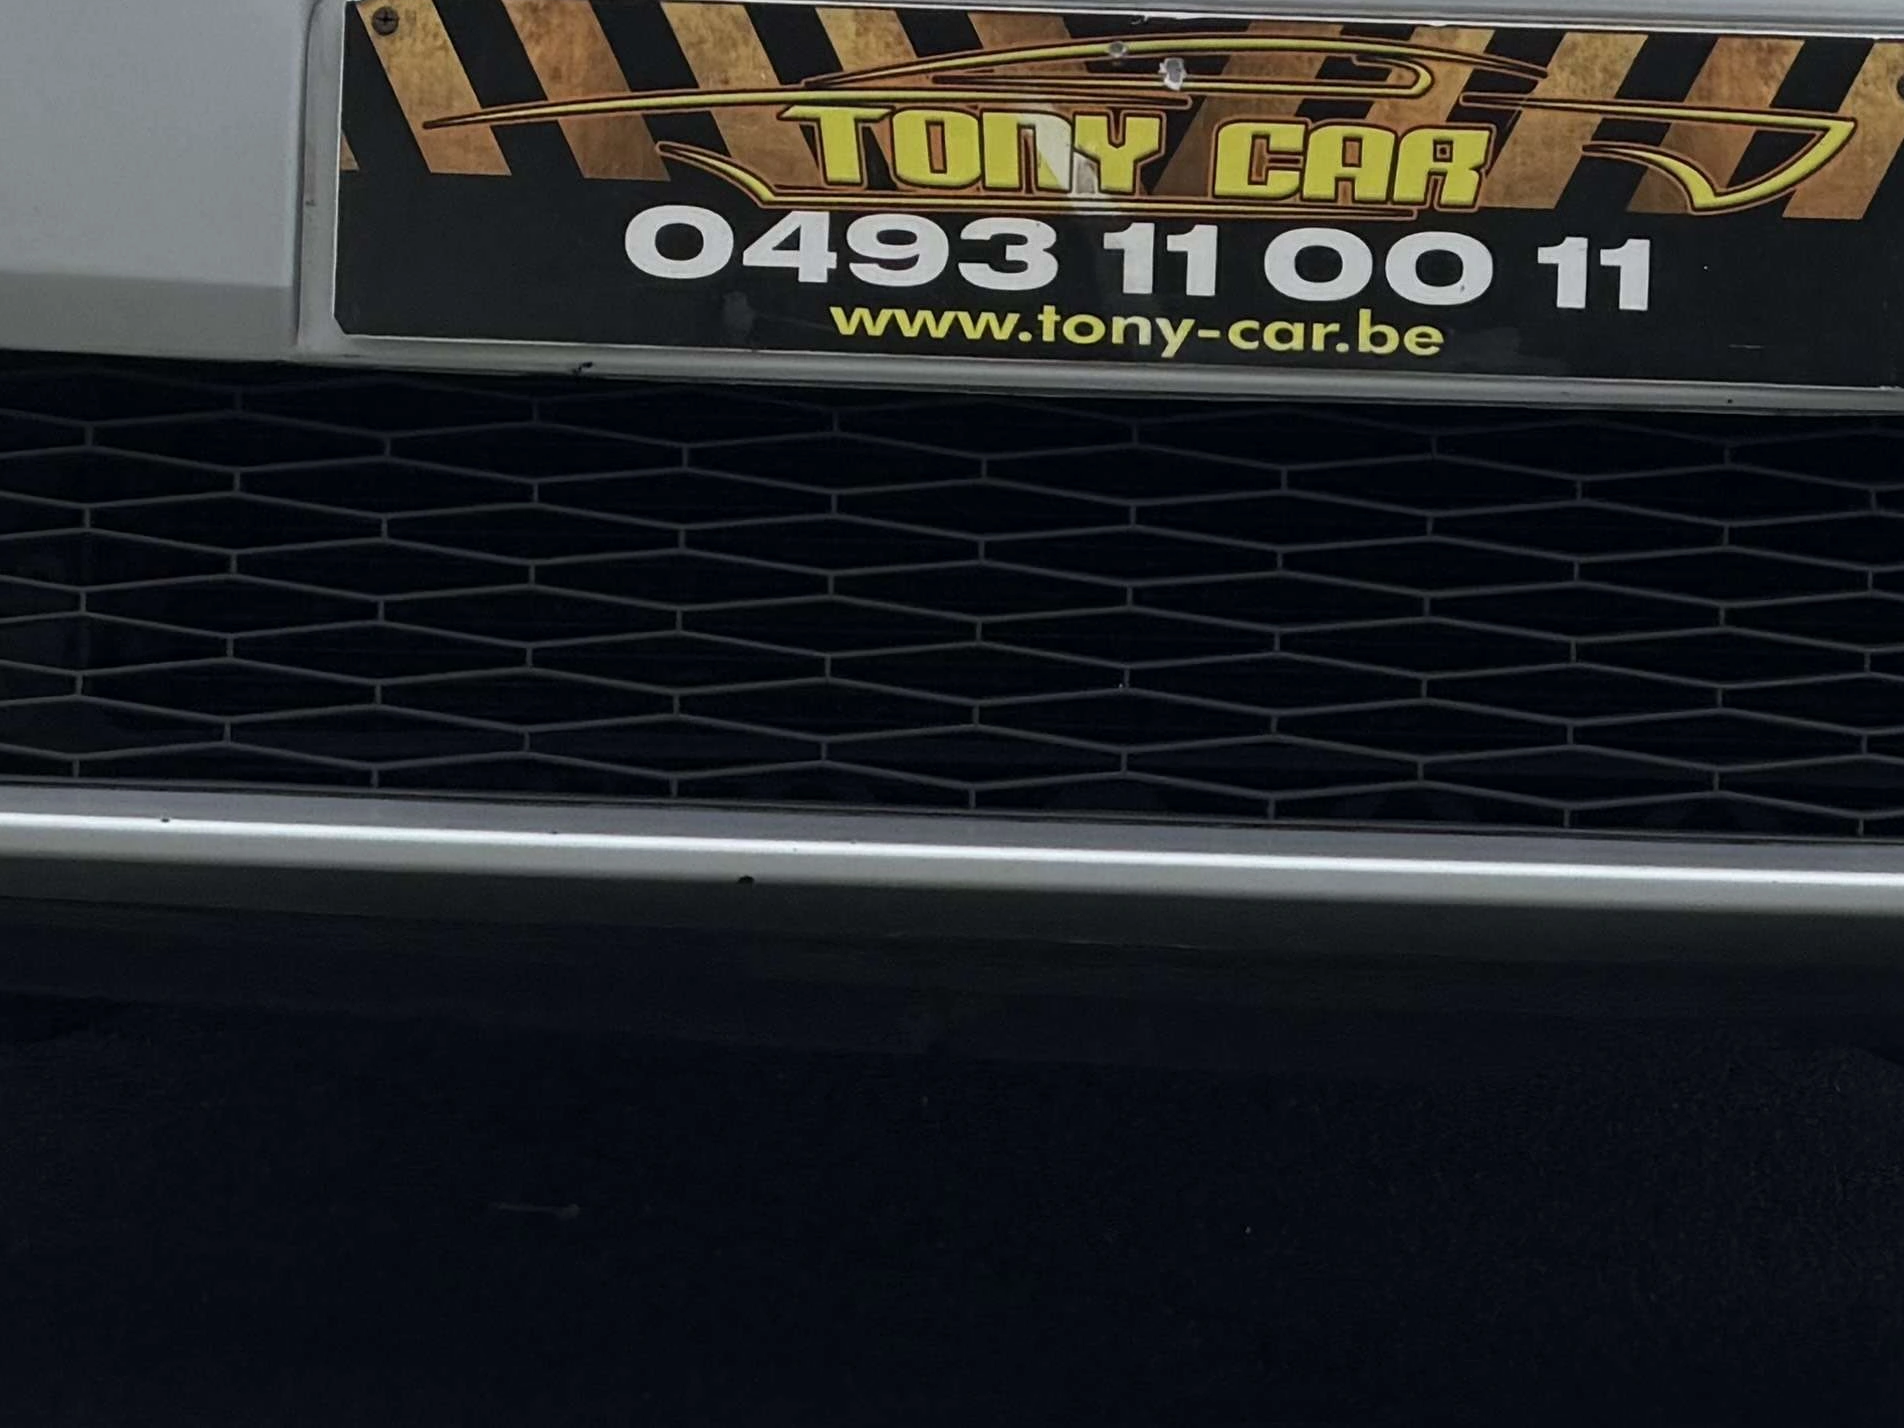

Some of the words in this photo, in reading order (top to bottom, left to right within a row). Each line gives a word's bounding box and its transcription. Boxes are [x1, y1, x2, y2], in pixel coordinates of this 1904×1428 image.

[780, 104, 1163, 194] TONY
[1214, 121, 1493, 207] CAR
[623, 204, 1060, 292] 0493
[1103, 221, 1219, 298] 11
[1263, 227, 1494, 306] 00
[1536, 235, 1652, 312] 11
[829, 304, 1445, 358] www.tony-car.be
